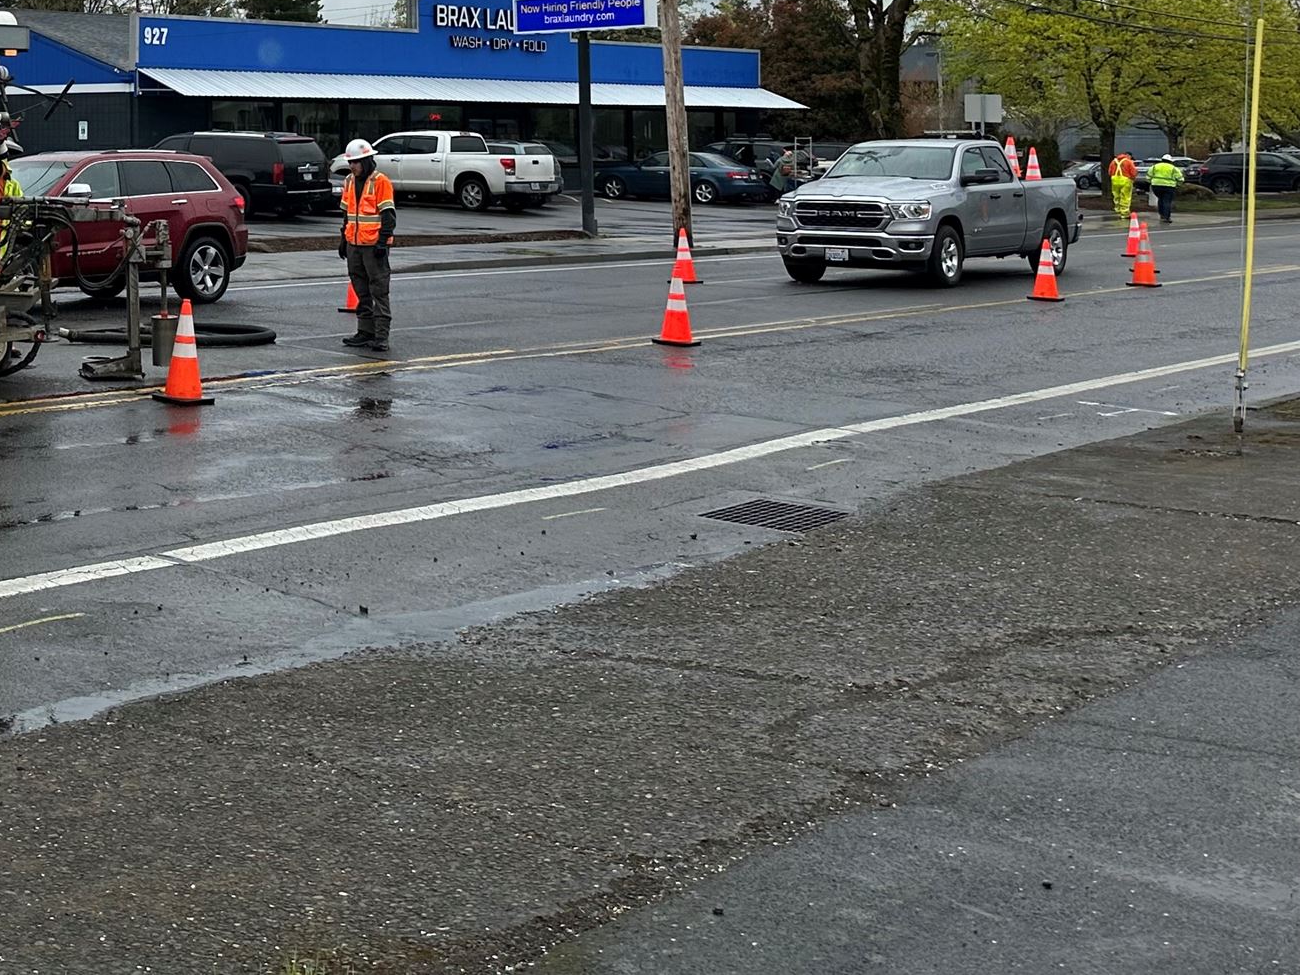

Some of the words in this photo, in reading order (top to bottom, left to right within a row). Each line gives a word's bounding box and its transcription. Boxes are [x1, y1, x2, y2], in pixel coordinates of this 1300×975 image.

[436, 4, 482, 28] BRAX
[520, 4, 540, 14] Now
[542, 3, 568, 13] Hiring
[569, 0, 605, 11] Friendly
[544, 12, 615, 24] braxlaundry.com
[144, 26, 168, 45] 927
[452, 35, 483, 49] WASH
[493, 38, 514, 50] DRY
[523, 39, 548, 53] FOLD
